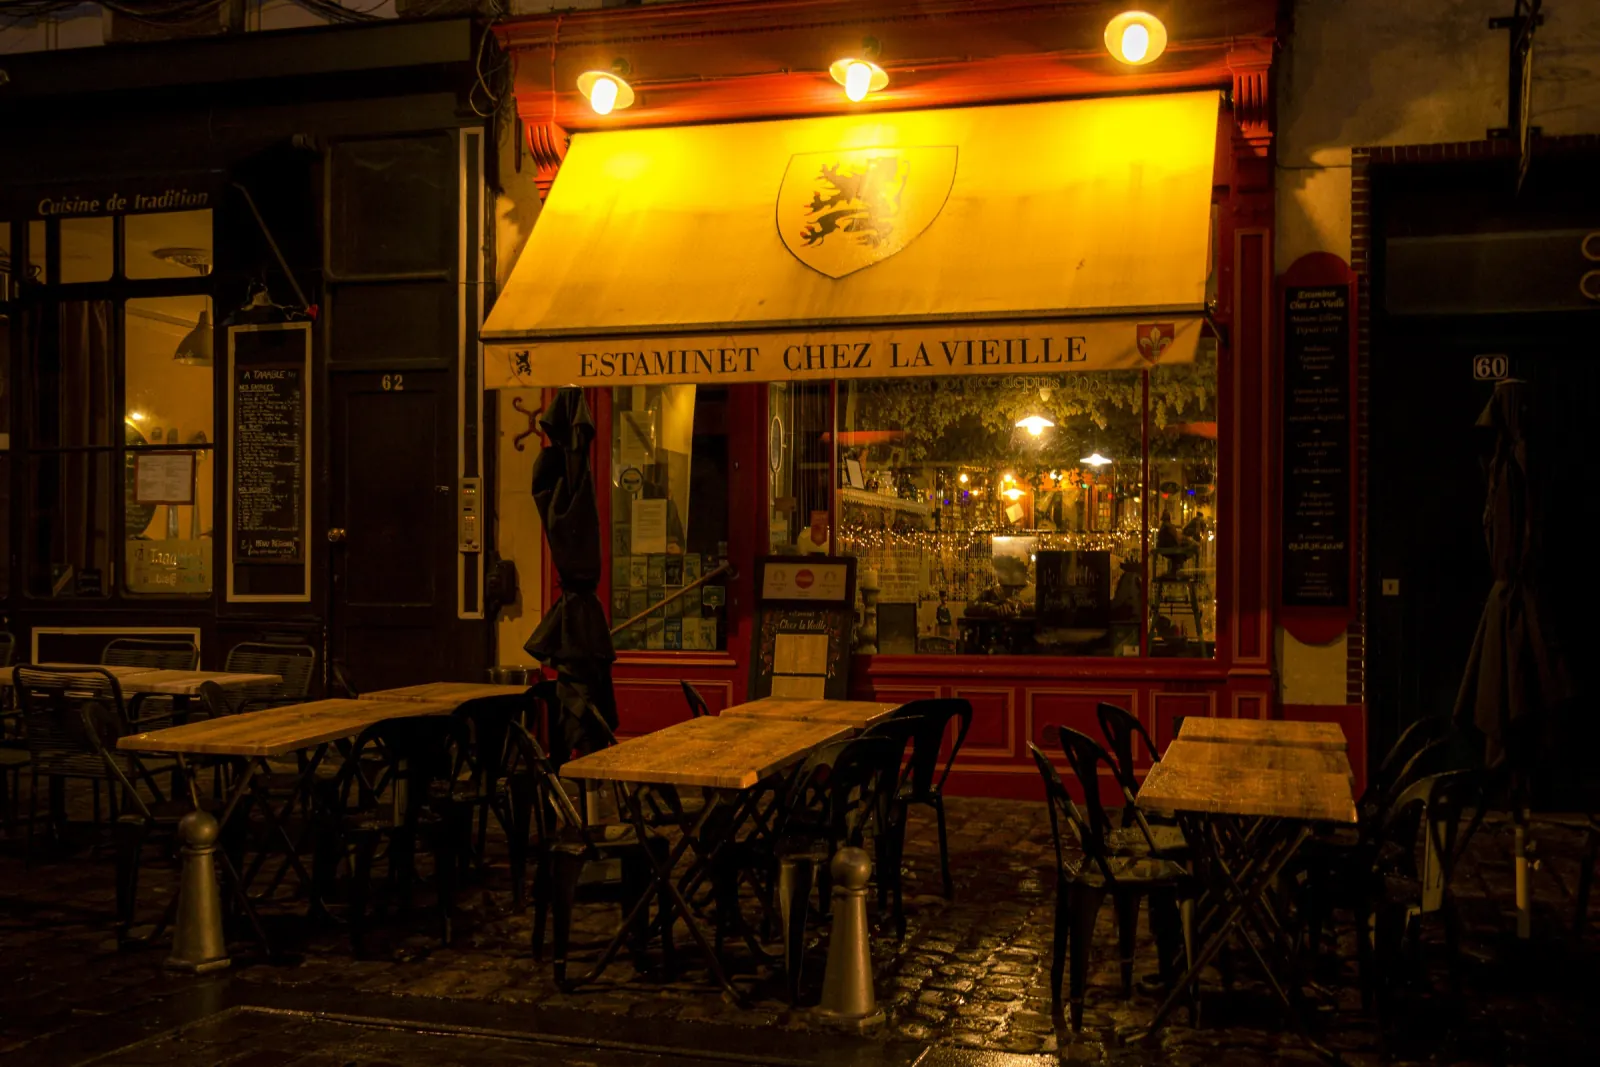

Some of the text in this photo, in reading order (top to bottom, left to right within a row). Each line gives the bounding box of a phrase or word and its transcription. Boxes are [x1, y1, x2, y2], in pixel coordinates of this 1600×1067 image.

[38, 188, 209, 216] Cuisine de tradition
[577, 336, 1087, 378] ESTAMINET CHEZ LA VIEILLE
[1476, 357, 1506, 378] 60
[382, 373, 404, 391] 62
